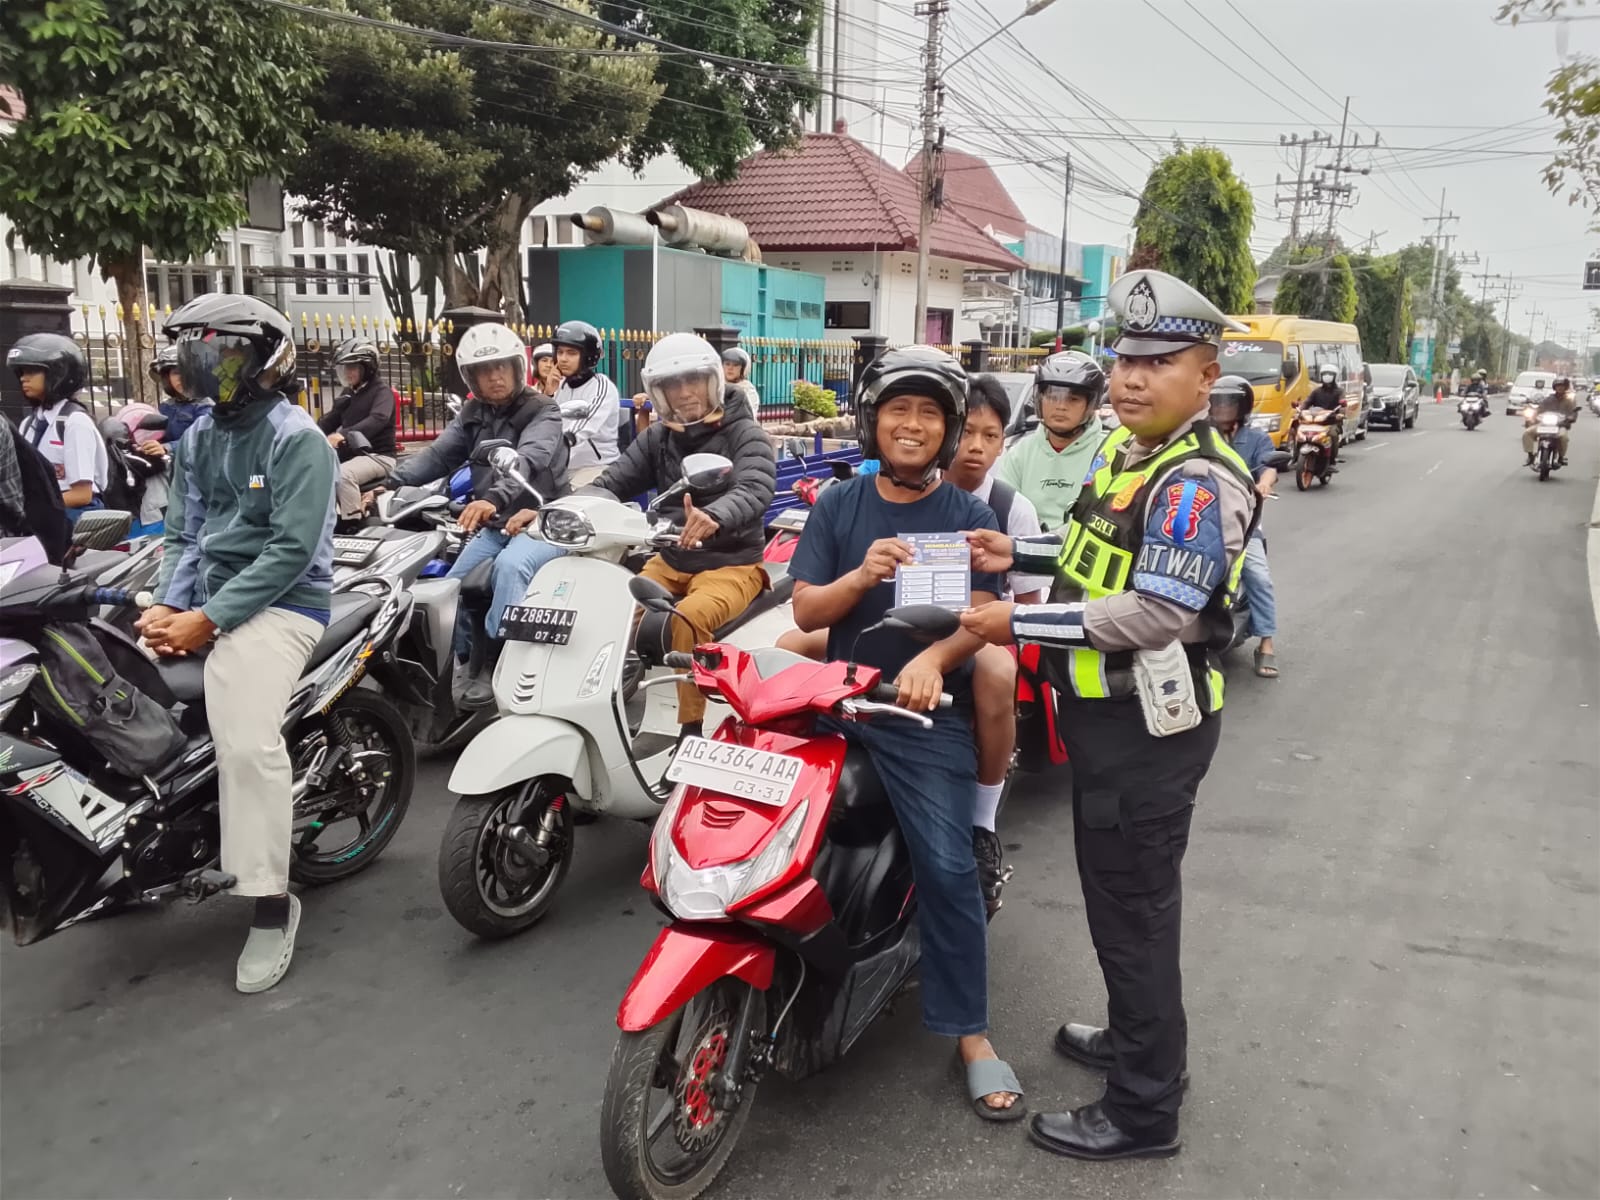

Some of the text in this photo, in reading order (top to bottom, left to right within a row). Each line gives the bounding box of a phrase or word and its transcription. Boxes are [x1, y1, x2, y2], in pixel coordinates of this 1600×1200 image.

[1136, 543, 1216, 591] ATWAL
[502, 606, 519, 621] AG
[681, 738, 800, 781] AG 4364 AAA
